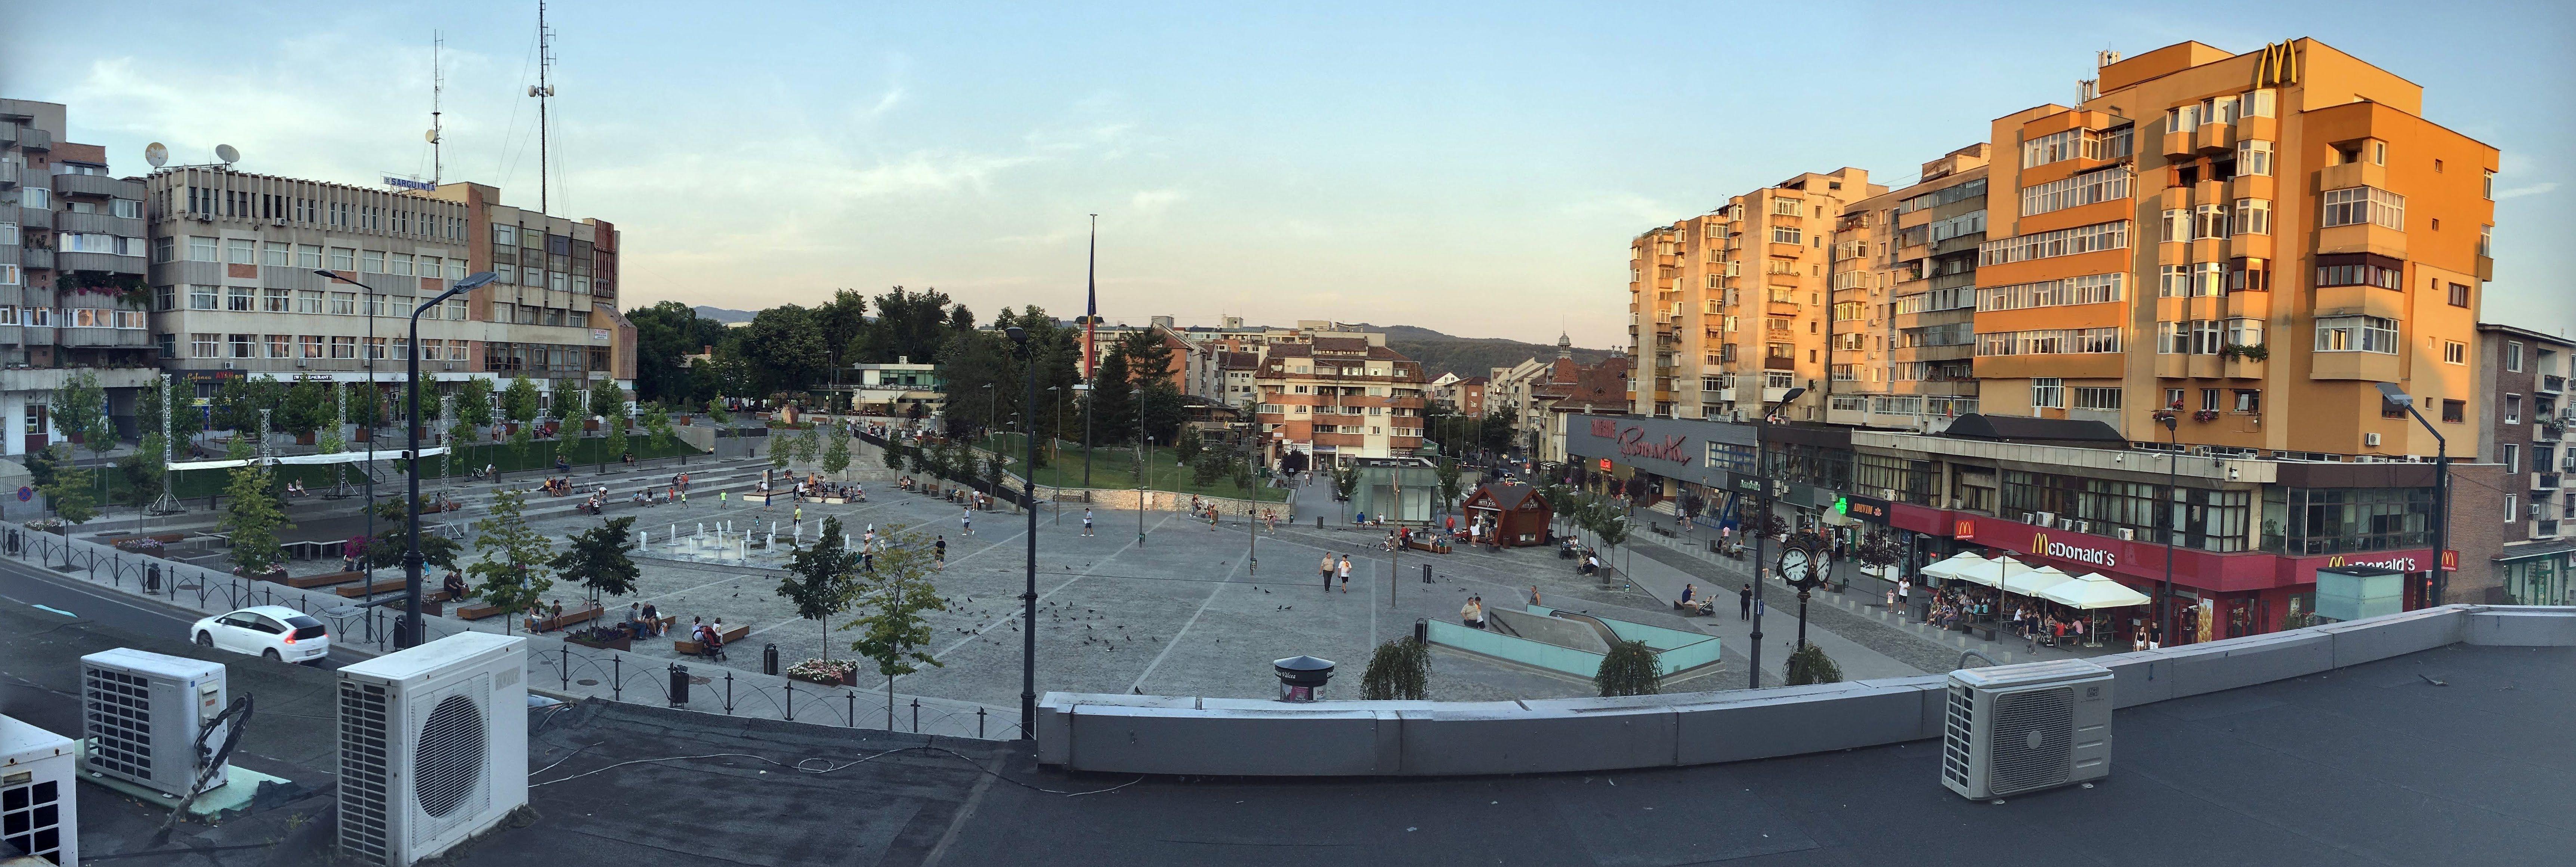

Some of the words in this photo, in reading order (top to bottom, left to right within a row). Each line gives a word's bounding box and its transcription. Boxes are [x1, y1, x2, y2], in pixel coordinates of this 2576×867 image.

[188, 373, 211, 382] Cafenea
[2032, 533, 2115, 567] McDonald's
[2329, 556, 2415, 571] Mnald's
